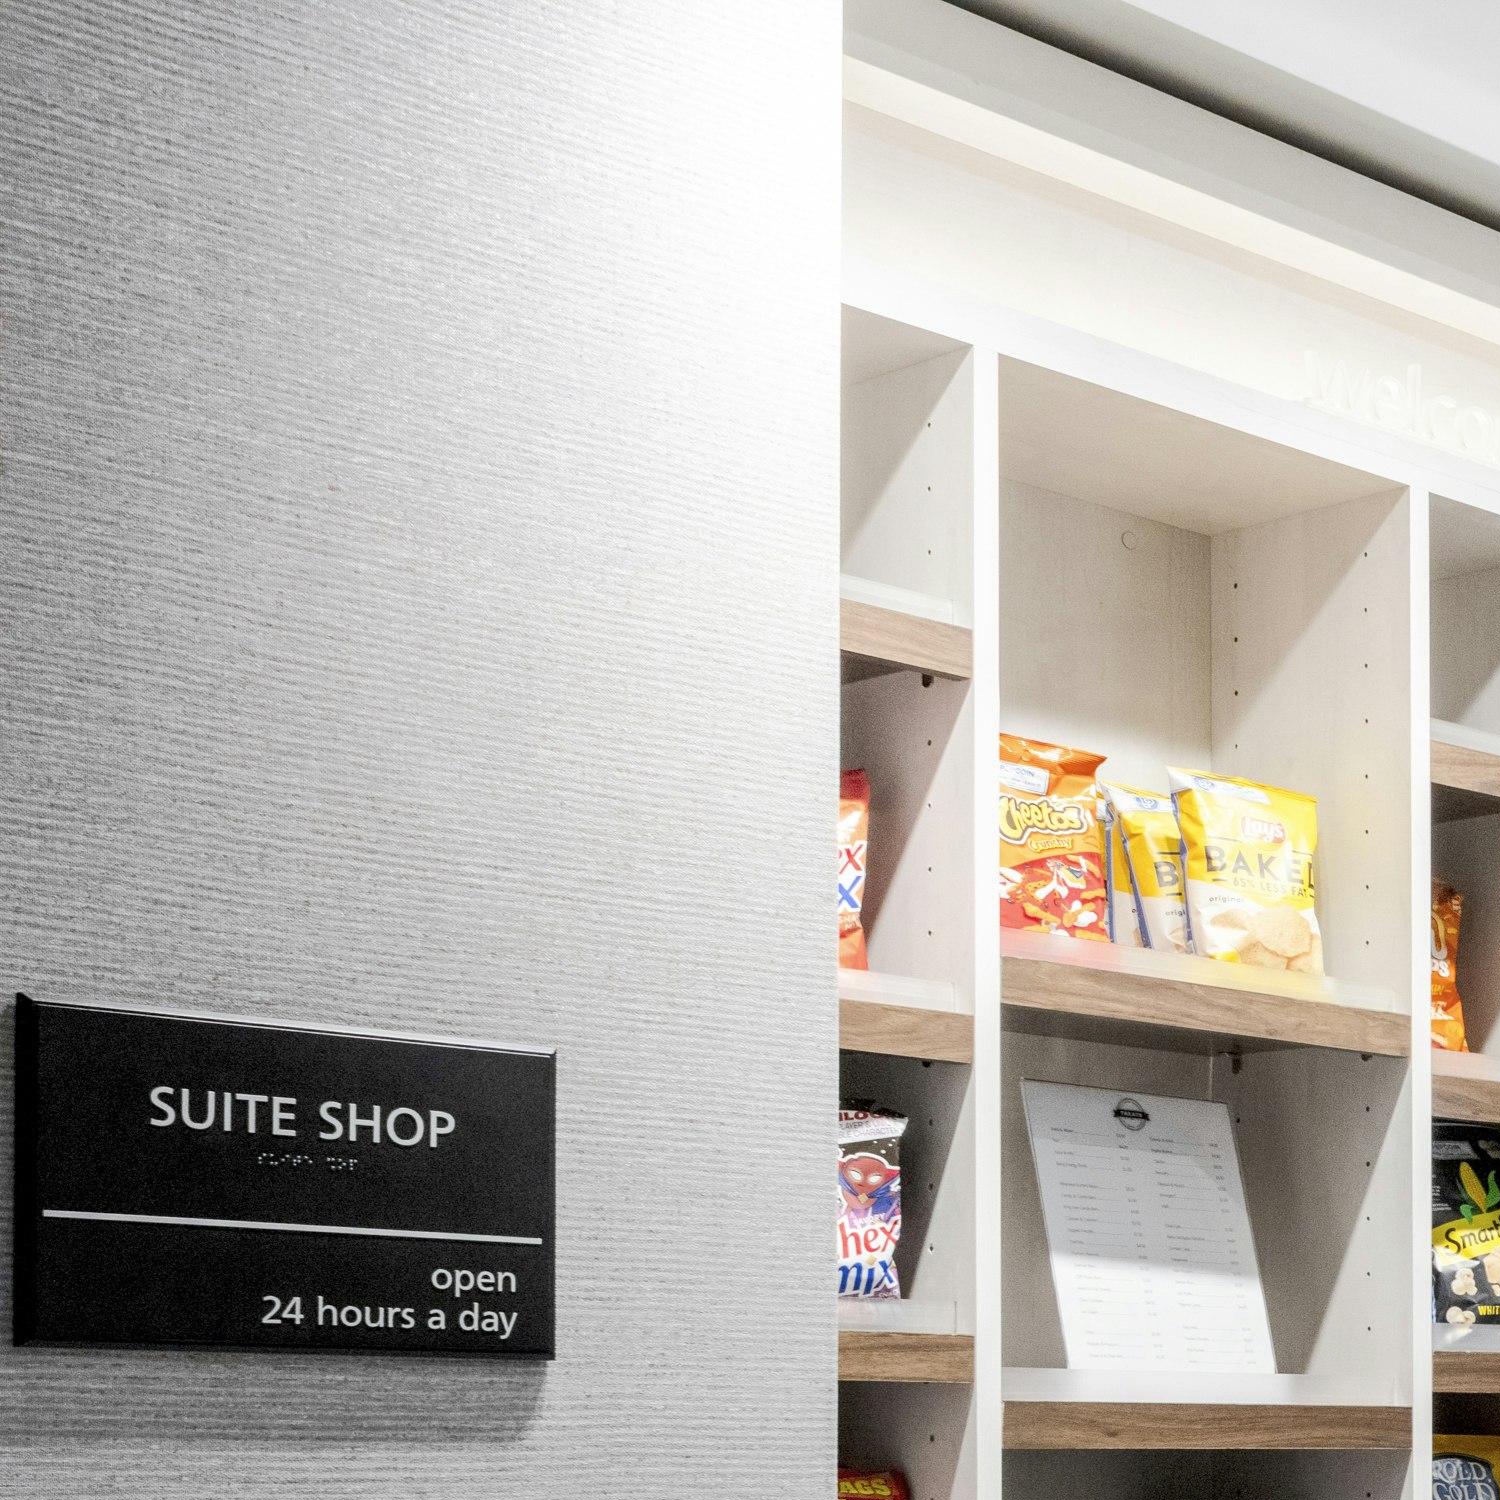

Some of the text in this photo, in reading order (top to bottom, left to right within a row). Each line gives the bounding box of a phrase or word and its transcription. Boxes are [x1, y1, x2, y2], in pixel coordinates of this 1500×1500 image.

[1029, 836, 1071, 852] Crunchy
[149, 1086, 456, 1149] SUITE SHOP
[837, 1221, 898, 1259] hex
[431, 1267, 517, 1300] open
[262, 1296, 518, 1339] 24 hours a day
